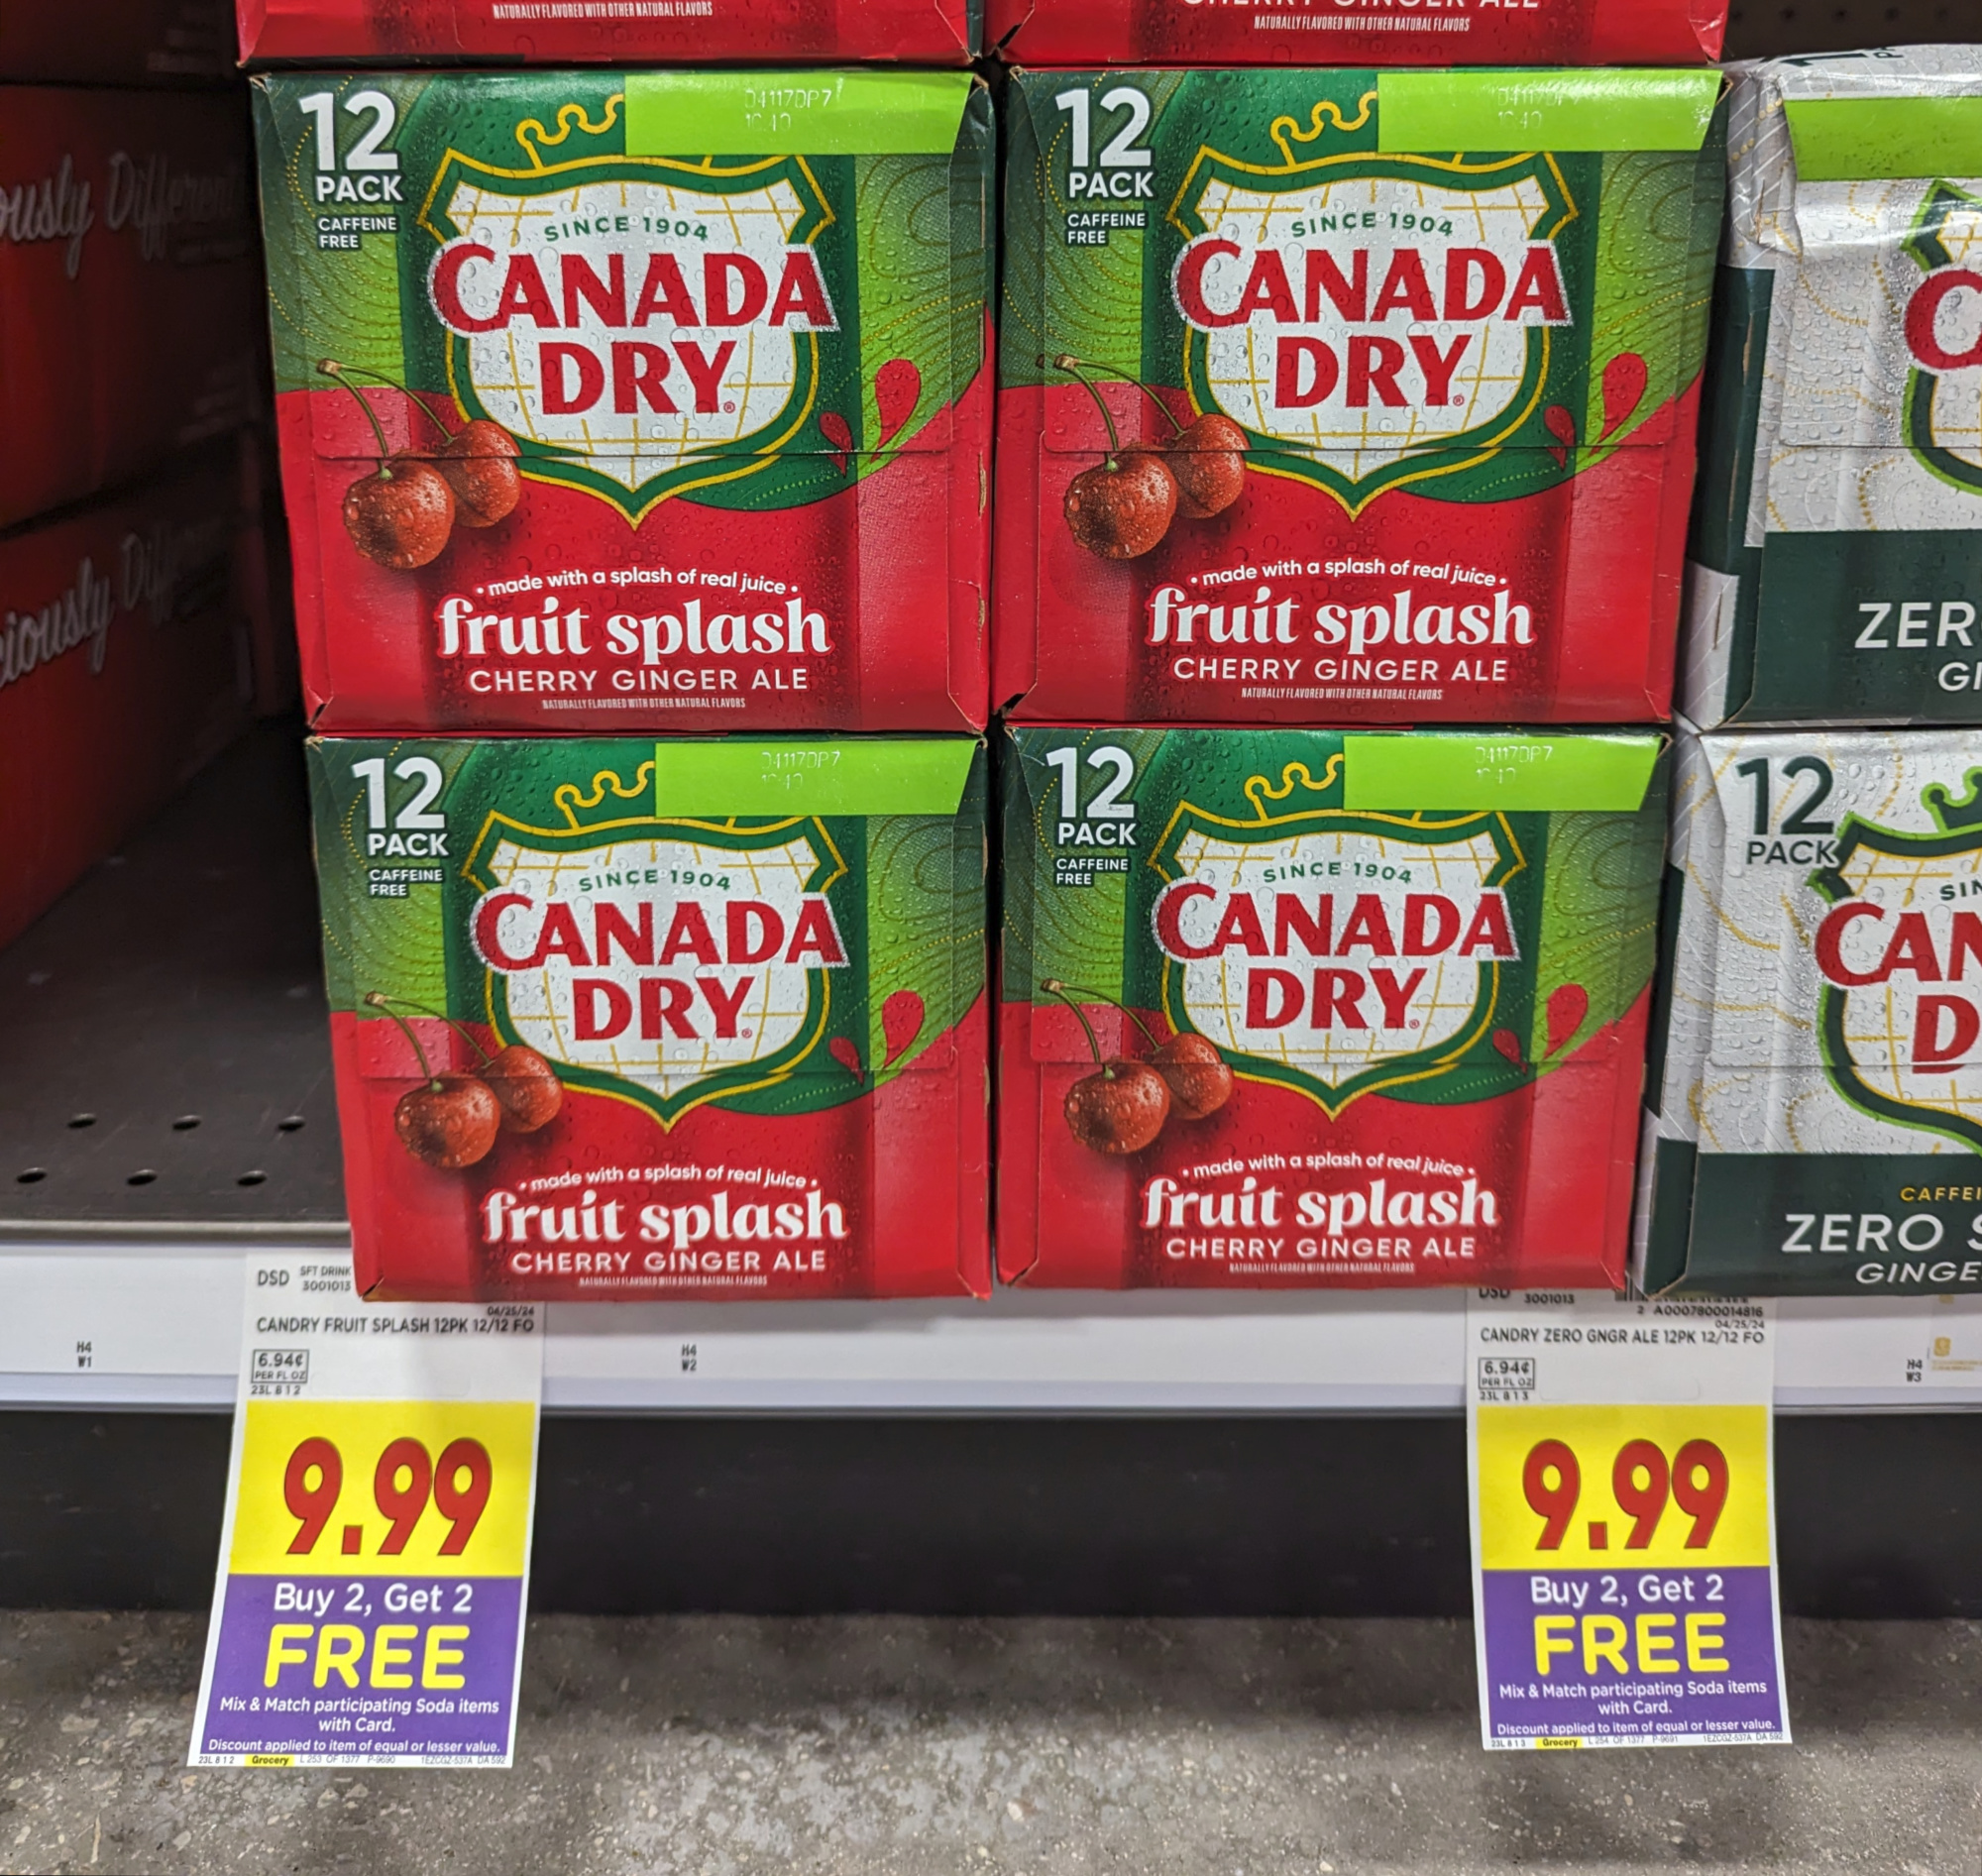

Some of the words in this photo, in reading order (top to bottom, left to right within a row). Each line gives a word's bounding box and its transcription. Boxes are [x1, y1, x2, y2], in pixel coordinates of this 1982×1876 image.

[1254, 16, 1301, 30] NATURALLY
[1302, 17, 1343, 31] FLAVORED
[1345, 17, 1367, 31] WITH
[1367, 17, 1392, 31] OTHER
[1393, 17, 1431, 32] NATURAL
[1433, 17, 1471, 32] FLAVORS
[299, 91, 398, 170] 12
[1055, 86, 1152, 166] 12
[316, 175, 403, 202] PACK
[1069, 171, 1154, 198] PACK
[318, 216, 396, 231] CAFFEINE
[544, 216, 628, 242] SINCE
[643, 216, 709, 242] 1904
[1067, 213, 1146, 227] CAFFEINE
[1291, 211, 1376, 238] SINCE
[1388, 212, 1454, 237] 1904
[319, 234, 359, 248] FREE
[1067, 231, 1106, 244] FREE
[433, 242, 835, 334] CANADA
[1176, 239, 1568, 328] CANADA
[539, 340, 737, 415] DRY
[1274, 334, 1474, 408] DRY
[489, 575, 543, 597] made
[547, 569, 588, 588] with
[593, 571, 606, 585] a
[610, 567, 672, 590] splash
[677, 569, 697, 584] of
[700, 571, 736, 589] real
[739, 573, 786, 596] juice
[438, 596, 593, 656] fruit
[606, 597, 832, 666] splash
[1149, 586, 1300, 645] fruit
[1313, 589, 1534, 655] splash
[1854, 601, 1982, 649] ZER
[470, 669, 598, 693] CHERRY
[611, 669, 737, 692] GINGER
[751, 668, 808, 690] ALE
[1173, 658, 1301, 680] CHERRY
[1314, 659, 1438, 681] GINGER
[1451, 660, 1507, 682] ALE
[352, 756, 445, 828] 12
[1046, 746, 1134, 818] 12
[1736, 756, 1833, 835] 12
[368, 832, 449, 856] PACK
[1057, 823, 1137, 845] PACK
[1056, 858, 1128, 870] CAFFEINE
[1747, 840, 1837, 864] PACK
[369, 868, 443, 881] CAFFEINE
[579, 869, 657, 892] SINCE
[671, 869, 731, 891] 1904
[1056, 873, 1091, 885] FREE
[1263, 861, 1341, 884] SINCE
[1354, 862, 1412, 883] 1904
[370, 884, 406, 896] FREE
[476, 892, 845, 971] CANADA
[1156, 883, 1515, 959] CANADA
[573, 976, 756, 1041] DRY
[1245, 967, 1427, 1030] DRY
[1145, 1176, 1283, 1227] fruit
[1295, 1177, 1498, 1235] splash
[485, 1190, 627, 1242] fruit
[639, 1189, 848, 1249] splash
[1781, 1213, 1944, 1253] ZERO
[1166, 1238, 1284, 1259] CHERRY
[1296, 1238, 1411, 1259] GINGER
[1422, 1238, 1475, 1258] ALE
[512, 1252, 631, 1273] CHERRY
[644, 1251, 760, 1272] GINGER
[772, 1250, 826, 1271] ALE
[258, 1269, 289, 1286] DSD
[299, 1266, 318, 1276] SFT
[320, 1266, 352, 1276] DRINK
[302, 1279, 352, 1291] 3001013
[1524, 1293, 1575, 1304] 3001013
[257, 1317, 320, 1333] CANDRY
[324, 1317, 368, 1333] FRUIT
[372, 1317, 429, 1333] SPLASH
[434, 1318, 468, 1333] 12PK
[473, 1317, 508, 1334] 12/12
[513, 1318, 534, 1332] FO
[1481, 1327, 1539, 1342] CANDRY
[1543, 1328, 1582, 1342] ZERO
[1587, 1328, 1627, 1343] GNGR
[1632, 1329, 1659, 1344] ALE
[1663, 1329, 1696, 1344] 12PK
[1702, 1330, 1738, 1345] 12/12
[1743, 1331, 1764, 1344] FO
[1714, 1319, 1765, 1329] 04/25/24
[76, 1341, 91, 1353] H4
[682, 1343, 697, 1357] H4
[255, 1371, 274, 1379] PER
[277, 1371, 288, 1379] FL
[291, 1371, 306, 1379] OZ
[1907, 1359, 1923, 1370] H4
[283, 1436, 493, 1556] 9.99
[1522, 1438, 1729, 1551] 9.99
[274, 1582, 335, 1617] Buy
[344, 1583, 373, 1616] 2,
[384, 1583, 443, 1613] Get
[452, 1583, 473, 1613] 2
[1530, 1576, 1589, 1609] Buy
[1599, 1576, 1628, 1606] 2,
[1637, 1575, 1696, 1602] Get
[1706, 1574, 1724, 1601] 2
[264, 1623, 471, 1690] FREE
[1533, 1612, 1730, 1677] FREE
[1499, 1684, 1525, 1699] Mix
[1528, 1683, 1539, 1698] &
[1543, 1683, 1587, 1699] Match
[1591, 1682, 1684, 1700] participating
[1688, 1681, 1724, 1696] Soda
[1727, 1681, 1767, 1694] items
[220, 1697, 246, 1711] Mix
[250, 1697, 260, 1710] &
[265, 1697, 310, 1712] Match
[314, 1697, 411, 1715] participating
[415, 1698, 455, 1713] Soda
[459, 1699, 499, 1713] items
[1597, 1701, 1629, 1714] with
[1633, 1700, 1672, 1714] Card.
[319, 1716, 351, 1731] with
[355, 1716, 395, 1732] Card.
[209, 1738, 262, 1751] Discount
[265, 1739, 310, 1753] applied
[313, 1740, 326, 1751] to
[329, 1740, 356, 1751] item
[359, 1739, 373, 1751] of
[375, 1740, 408, 1753] equal
[410, 1742, 424, 1752] or
[427, 1740, 462, 1752] lesser
[465, 1741, 500, 1752] value.
[252, 1755, 289, 1766] Grocery
